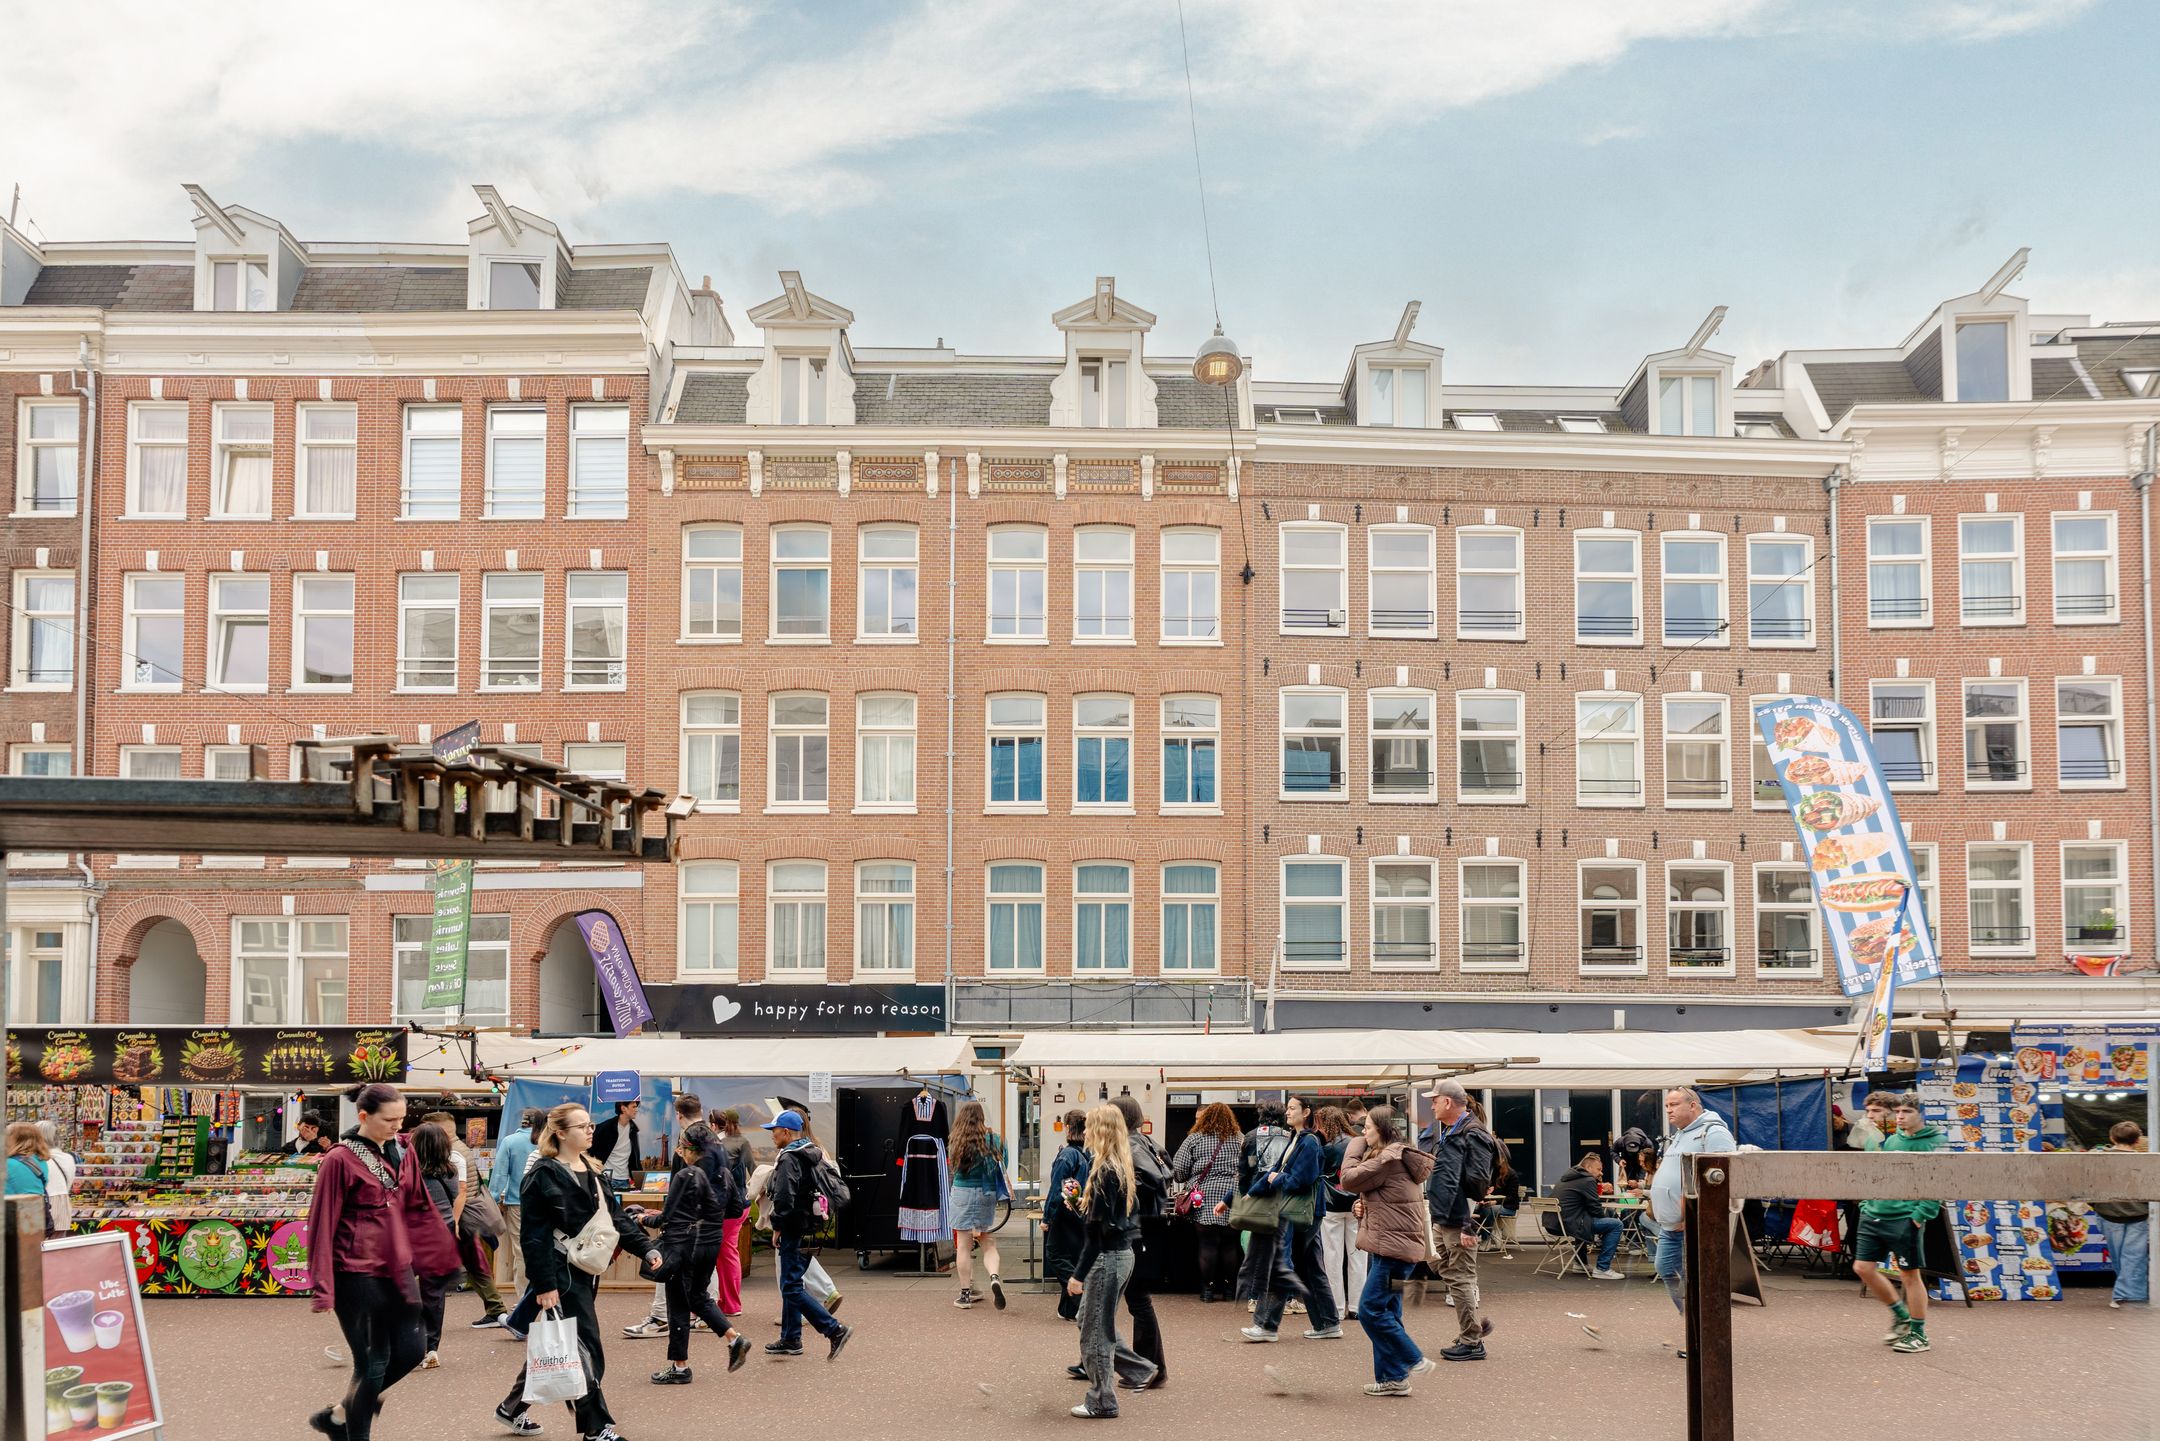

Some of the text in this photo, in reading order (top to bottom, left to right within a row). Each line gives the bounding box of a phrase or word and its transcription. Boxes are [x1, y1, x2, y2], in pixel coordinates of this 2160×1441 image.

[754, 1001, 940, 1021] happy for no reason
[47, 1030, 77, 1040] Cannabis
[117, 1031, 148, 1042] Cannabis
[191, 1030, 220, 1040] Cannabis
[276, 1030, 317, 1040] Cannabis Oil
[355, 1030, 383, 1039] Cannabis
[127, 1038, 157, 1048] Brownie
[201, 1036, 221, 1045] Seeds
[99, 1280, 120, 1290] Ube
[98, 1288, 127, 1301] Latte
[533, 1354, 568, 1367] Kruithof
